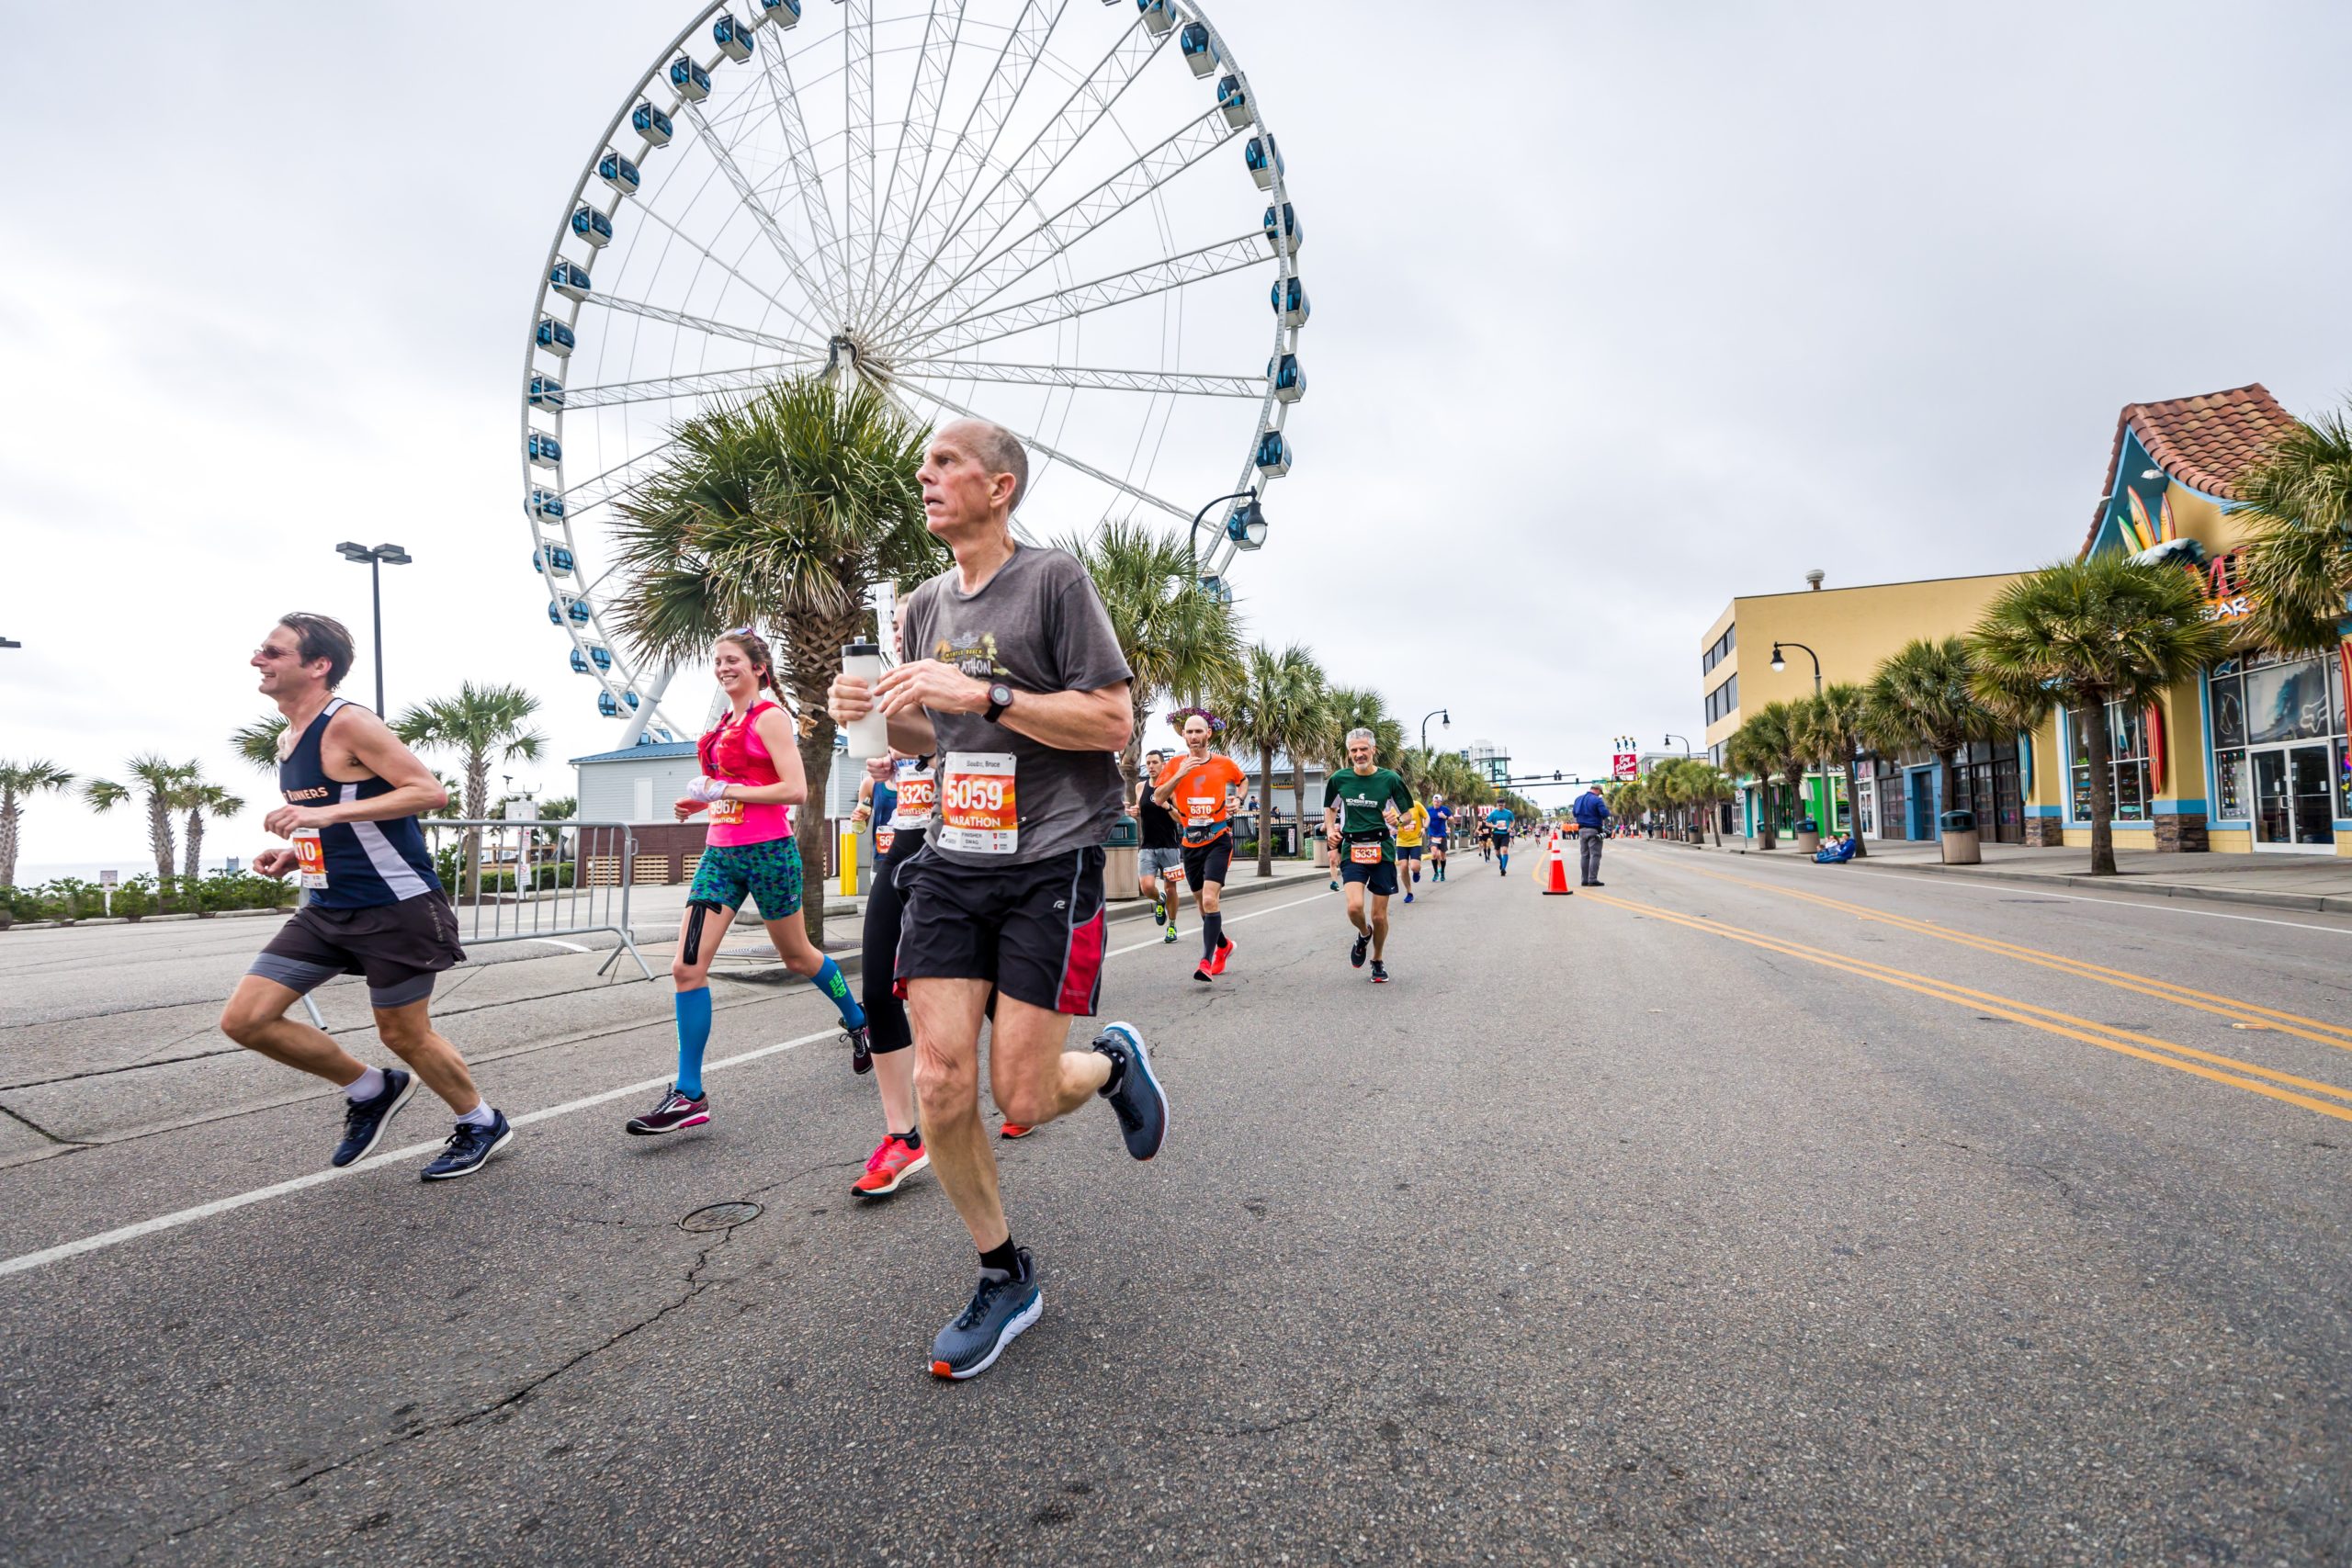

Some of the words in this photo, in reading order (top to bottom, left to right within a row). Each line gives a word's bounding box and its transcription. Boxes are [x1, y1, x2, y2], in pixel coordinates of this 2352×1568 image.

[949, 657, 991, 675] ATHON
[899, 783, 933, 805] 5326
[946, 779, 1003, 811] 5059
[1190, 805, 1212, 815] 6310
[949, 815, 1001, 828] MARATHON
[1354, 848, 1377, 859] 5334
